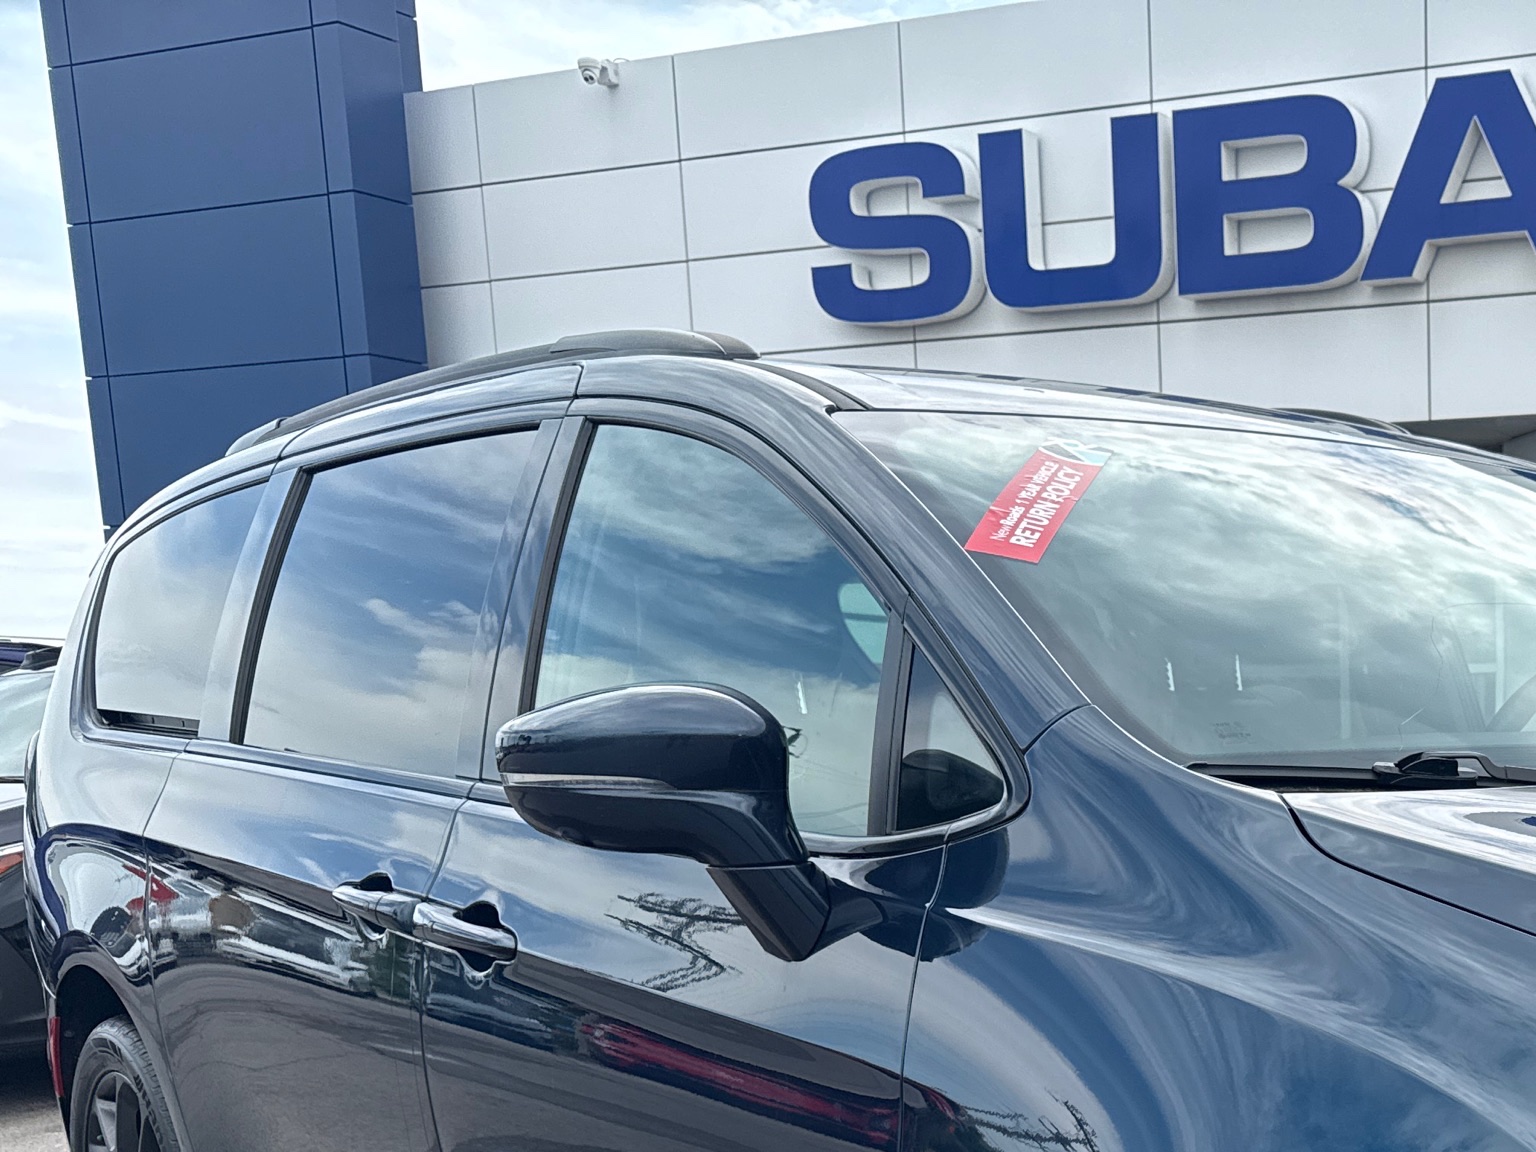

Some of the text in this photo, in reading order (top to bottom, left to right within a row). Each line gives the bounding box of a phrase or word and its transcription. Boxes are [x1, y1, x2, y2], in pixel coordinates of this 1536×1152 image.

[1009, 466, 1083, 548] RETURN POLICY
[1016, 483, 1042, 500] YEAR
